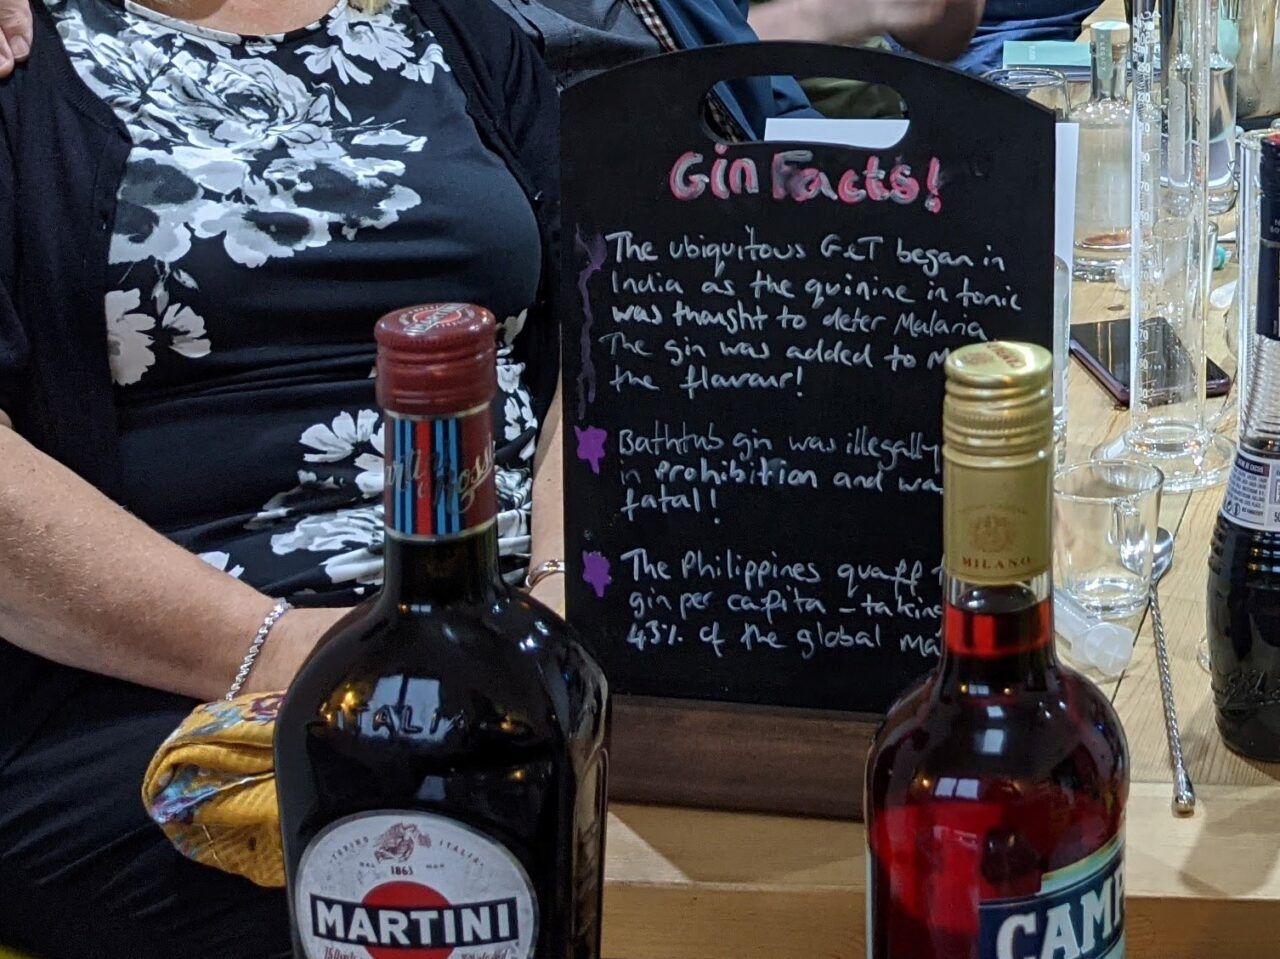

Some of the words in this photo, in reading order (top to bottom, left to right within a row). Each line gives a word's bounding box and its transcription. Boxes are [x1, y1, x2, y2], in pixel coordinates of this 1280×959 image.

[669, 142, 760, 201] Gin
[771, 149, 942, 214] Facts!
[605, 230, 659, 263] The
[669, 224, 806, 278] ubiquitous
[896, 237, 974, 277] began
[983, 244, 1006, 271] in
[611, 270, 684, 295] India
[701, 278, 736, 297] as
[750, 269, 796, 299] the
[804, 273, 916, 309] quinine
[927, 280, 949, 303] in
[956, 277, 1022, 311] tonic
[612, 303, 663, 326] was
[776, 304, 808, 330] to
[822, 306, 887, 332] deter
[894, 309, 989, 340] Malaria
[598, 331, 653, 356] The
[664, 335, 707, 366] gin
[719, 341, 771, 360] was
[785, 338, 873, 368] added
[883, 344, 917, 372] to
[609, 364, 660, 392] the
[619, 419, 725, 456] Bathtub
[732, 428, 773, 461] gin
[788, 436, 837, 452] was
[846, 425, 941, 474] illegally
[620, 459, 641, 485] in
[833, 469, 883, 492] and
[899, 476, 944, 496] wa
[620, 547, 672, 582] The
[681, 548, 822, 590] Philippines
[837, 558, 923, 600] quaff
[629, 587, 672, 618] gin
[680, 591, 714, 620] per
[727, 585, 827, 624] capita
[740, 622, 789, 651] the
[796, 621, 881, 659] global
[390, 865, 414, 876] 1863
[315, 900, 511, 946] MARTINI
